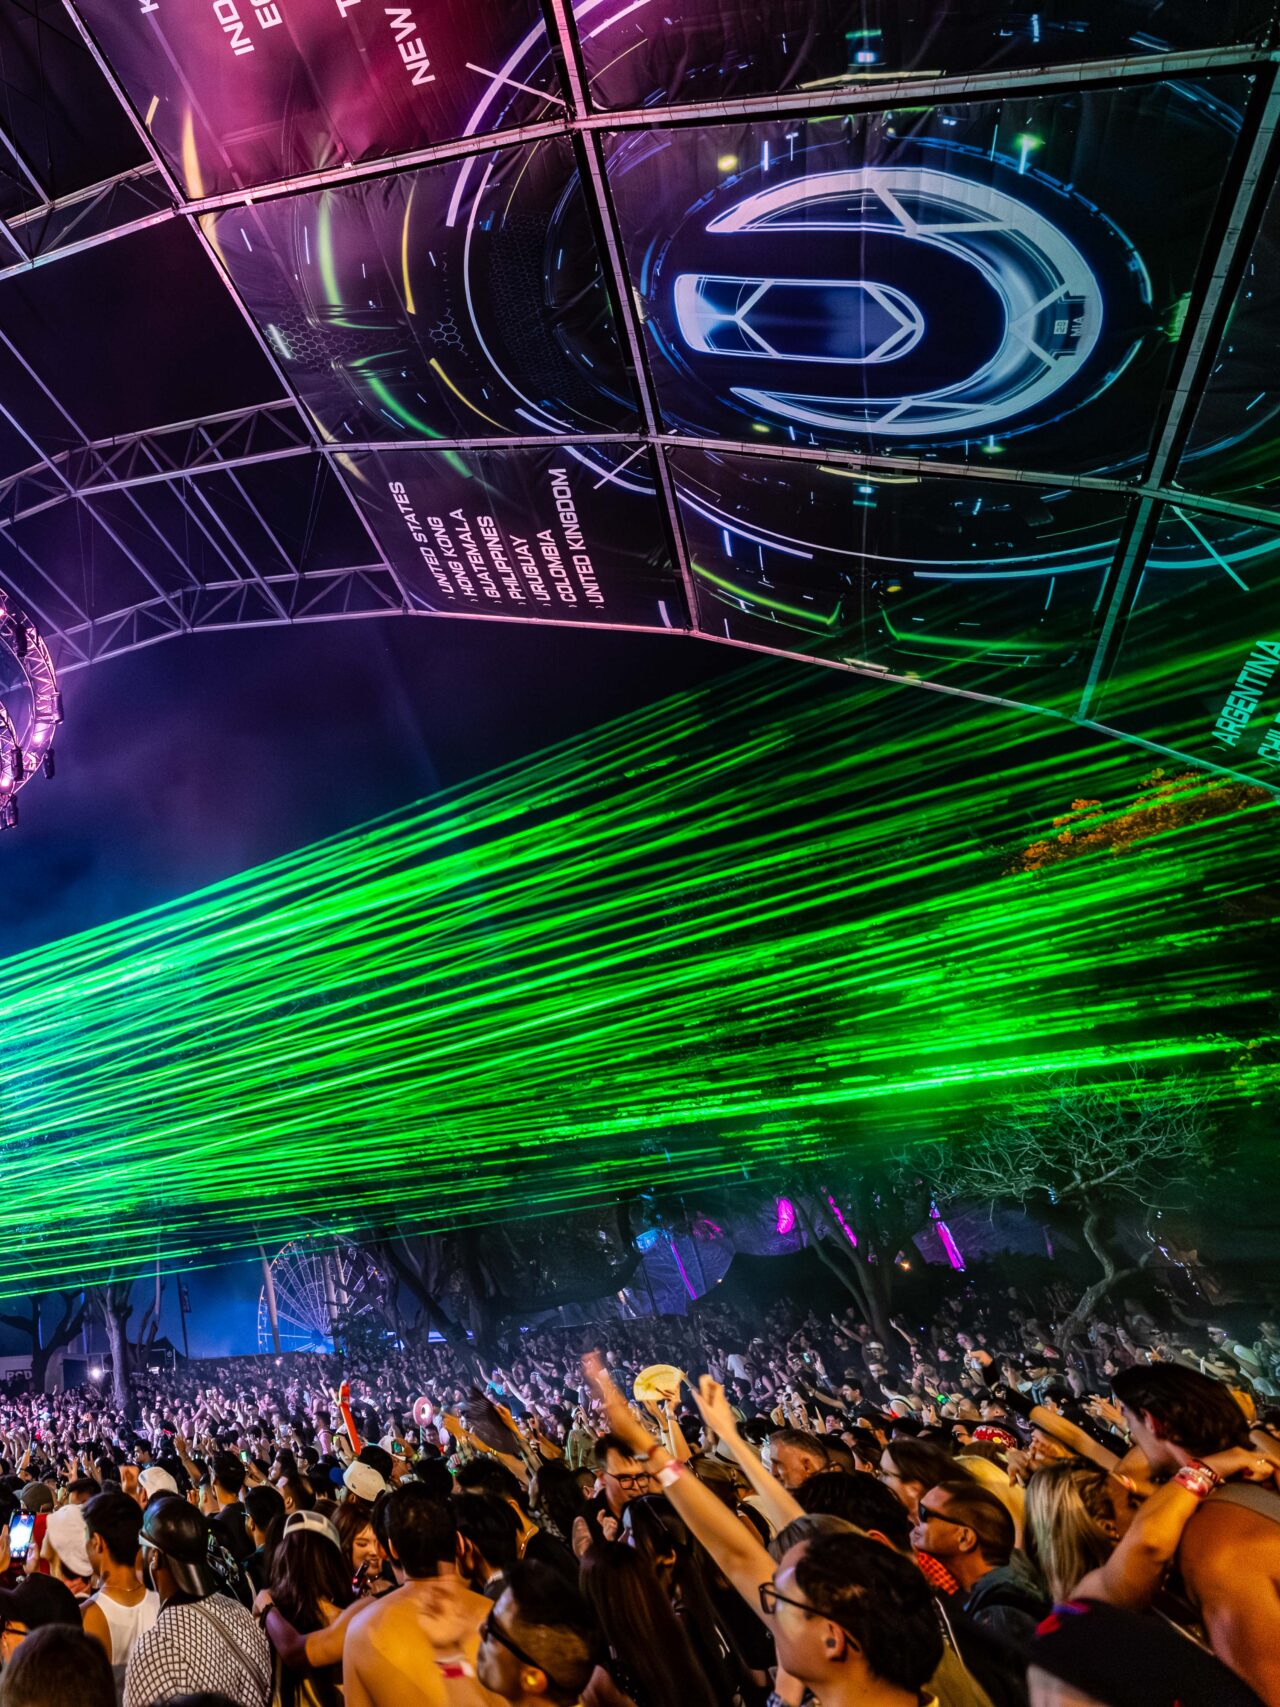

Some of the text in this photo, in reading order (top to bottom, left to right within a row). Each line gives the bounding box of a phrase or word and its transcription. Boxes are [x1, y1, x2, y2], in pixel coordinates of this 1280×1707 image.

[384, 8, 436, 86] NEW
[389, 481, 453, 593] UNITED STATES
[427, 516, 477, 596] HONG KONG
[449, 508, 501, 598] GUATEMALA
[477, 515, 526, 600] PHILIPPINES
[510, 535, 551, 601] URUGUAY
[537, 529, 578, 602] COLOMBIA
[548, 469, 604, 603] UNITED KINGDOM
[1211, 640, 1280, 747] ARGENTINA
